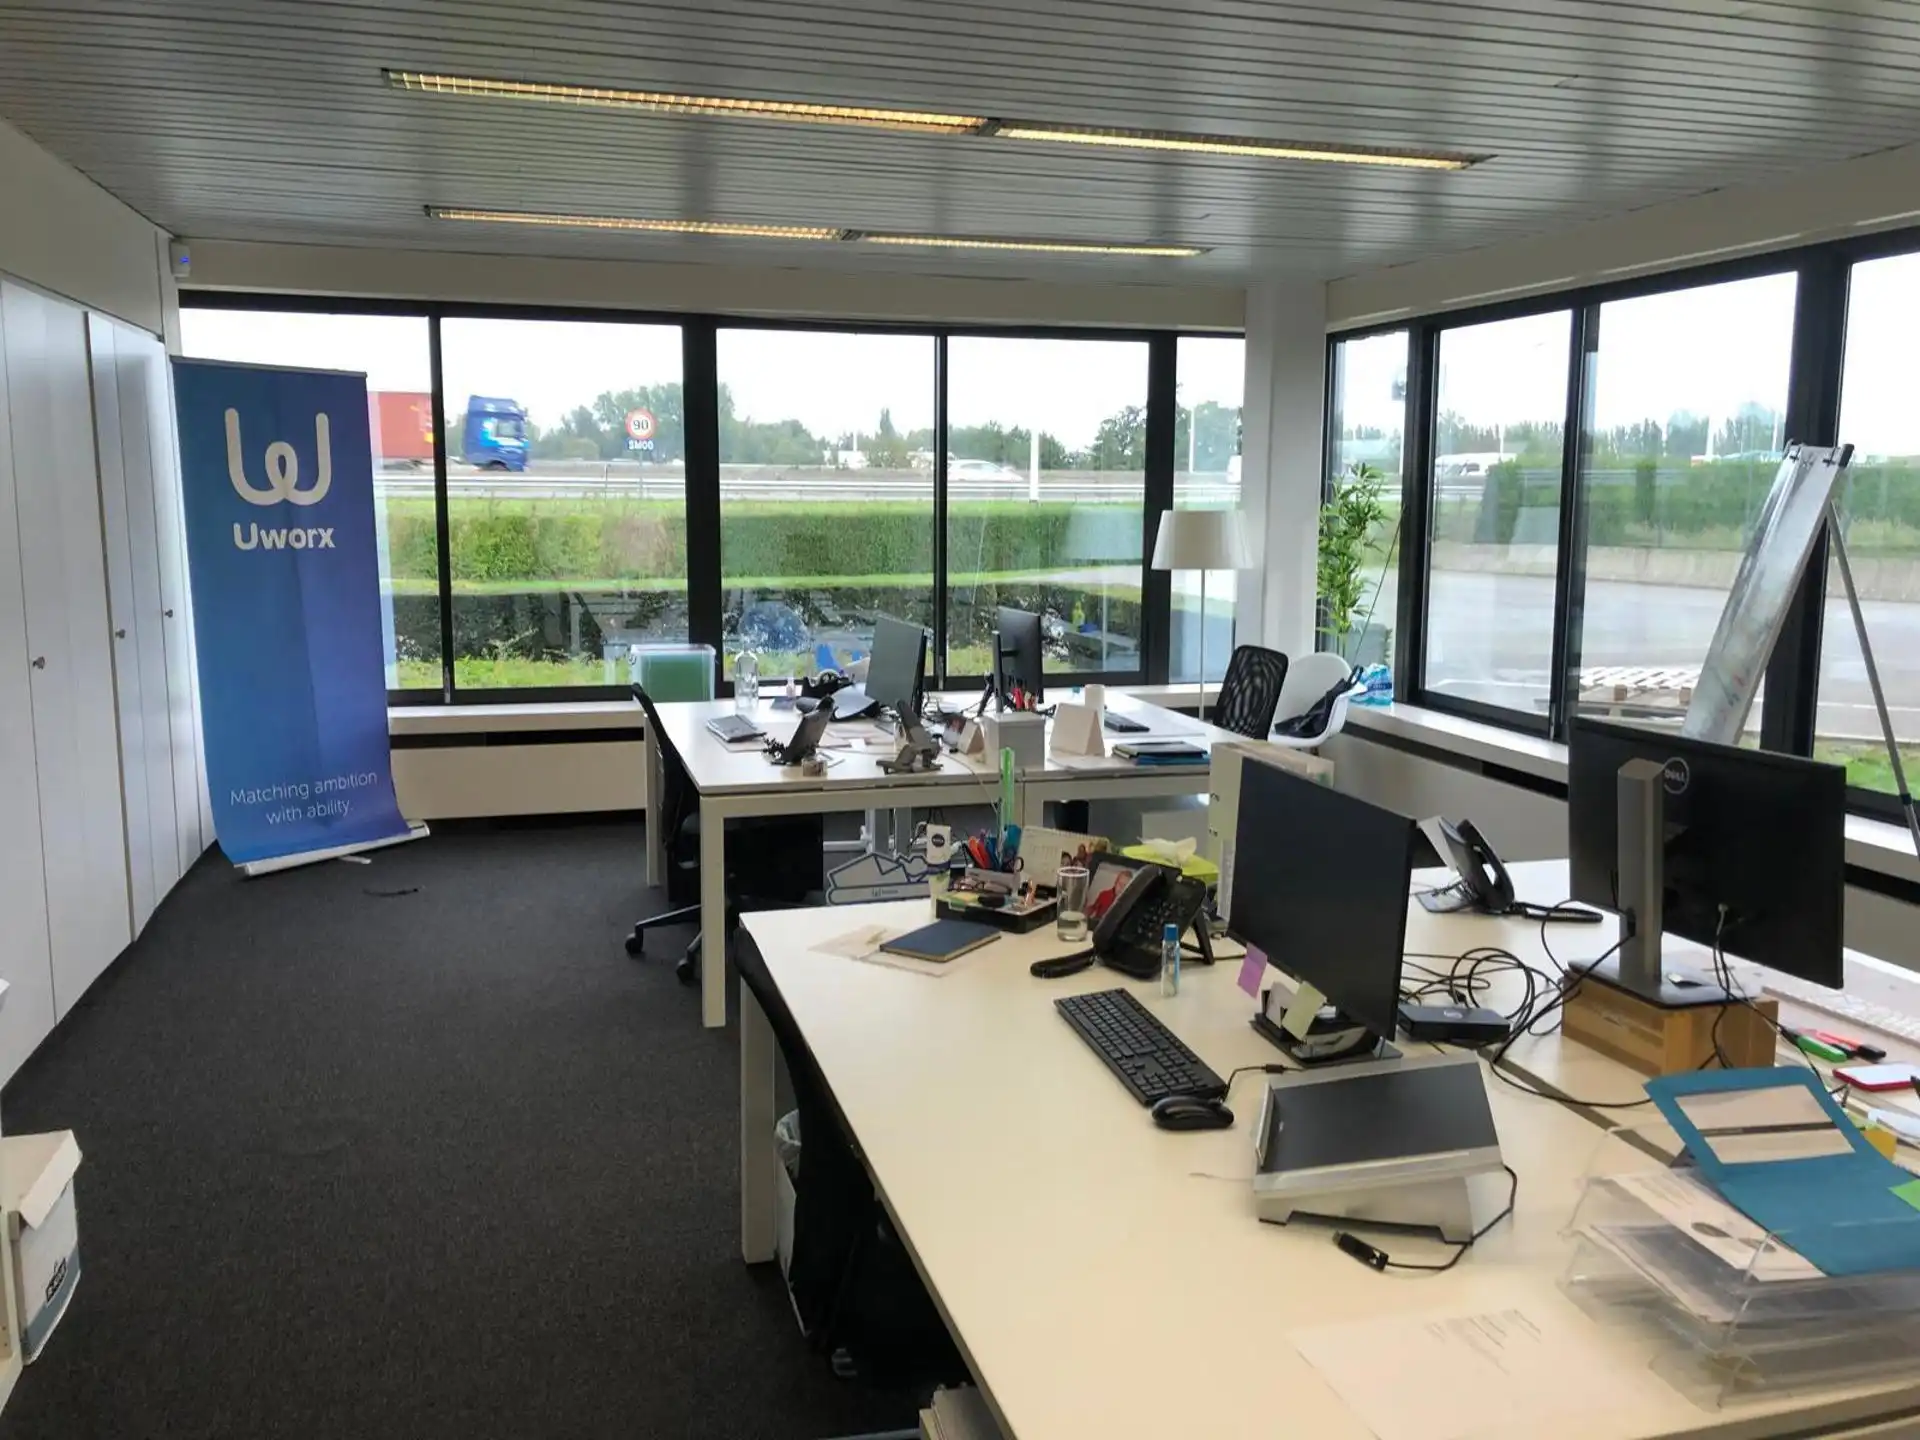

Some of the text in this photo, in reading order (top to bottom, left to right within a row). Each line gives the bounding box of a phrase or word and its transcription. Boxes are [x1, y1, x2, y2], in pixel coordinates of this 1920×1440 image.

[633, 419, 649, 431] 90
[233, 522, 336, 551] Uworx
[230, 771, 378, 806] Matching ambition
[266, 805, 302, 825] with
